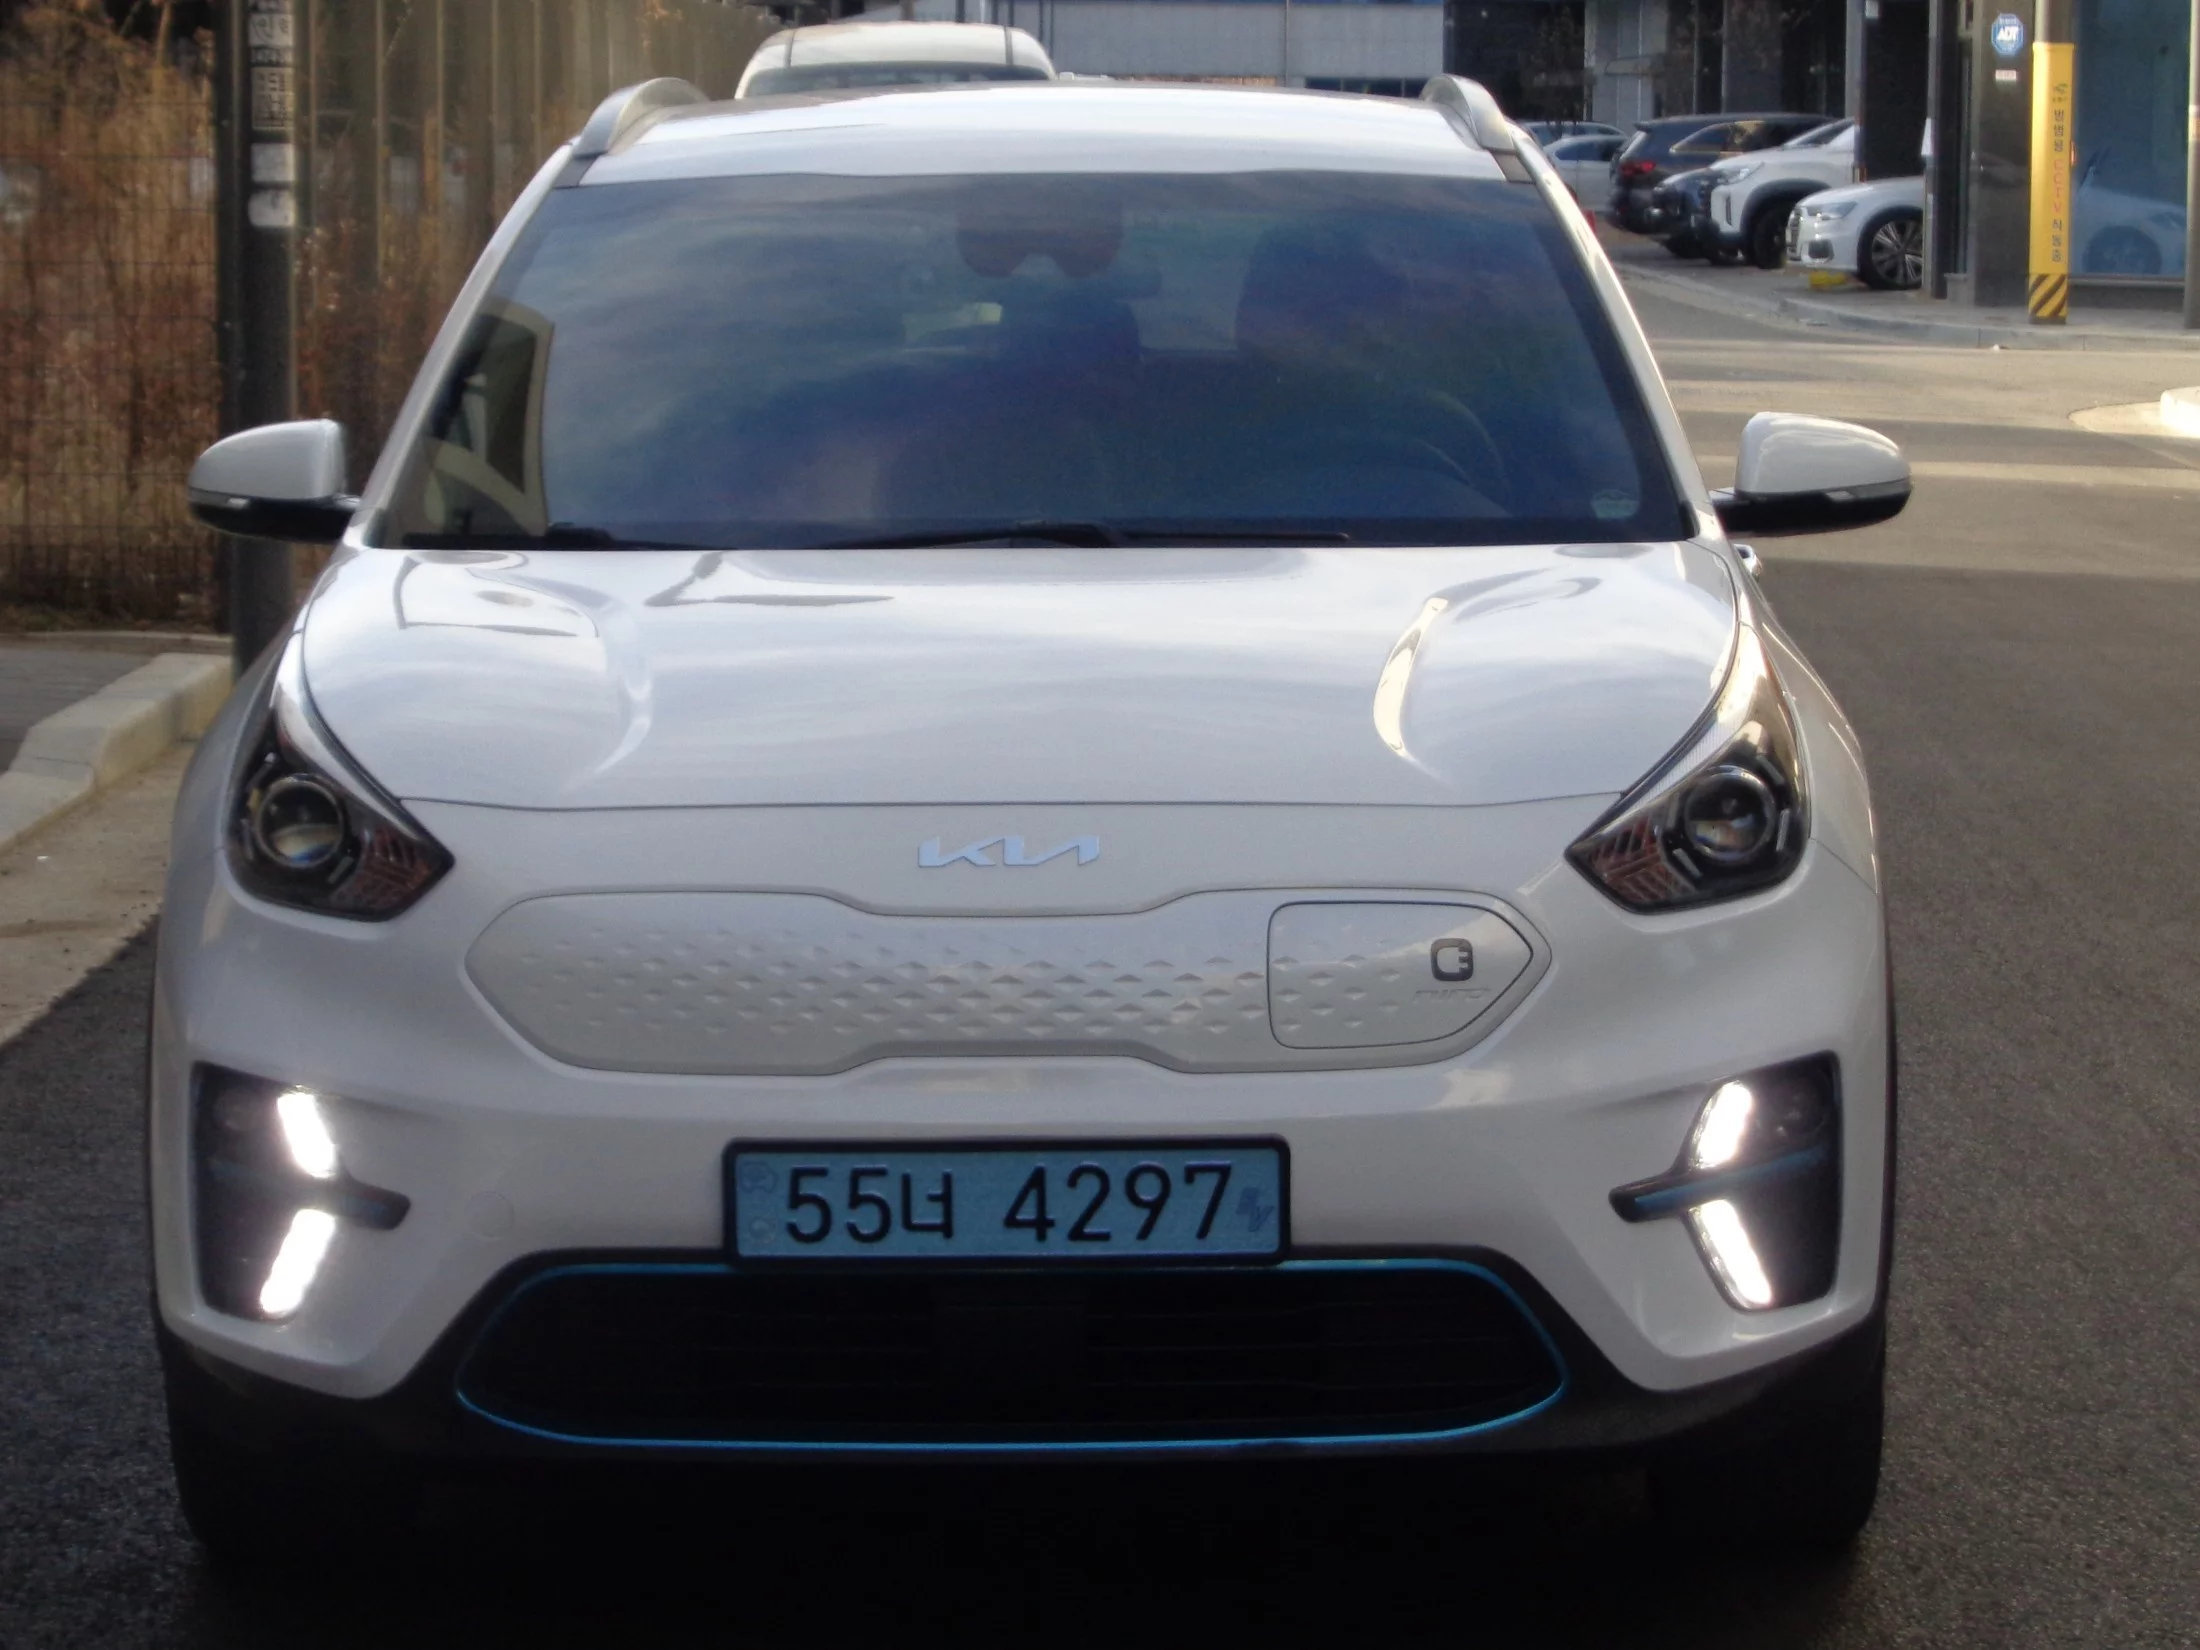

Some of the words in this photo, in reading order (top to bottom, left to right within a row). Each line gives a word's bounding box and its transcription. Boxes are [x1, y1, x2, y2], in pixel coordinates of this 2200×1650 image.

[1996, 26, 2019, 41] ADT
[2053, 159, 2064, 213] CCTV
[918, 836, 1099, 867] KIA
[785, 1165, 954, 1243] 55너
[1003, 1161, 1233, 1242] 4297
